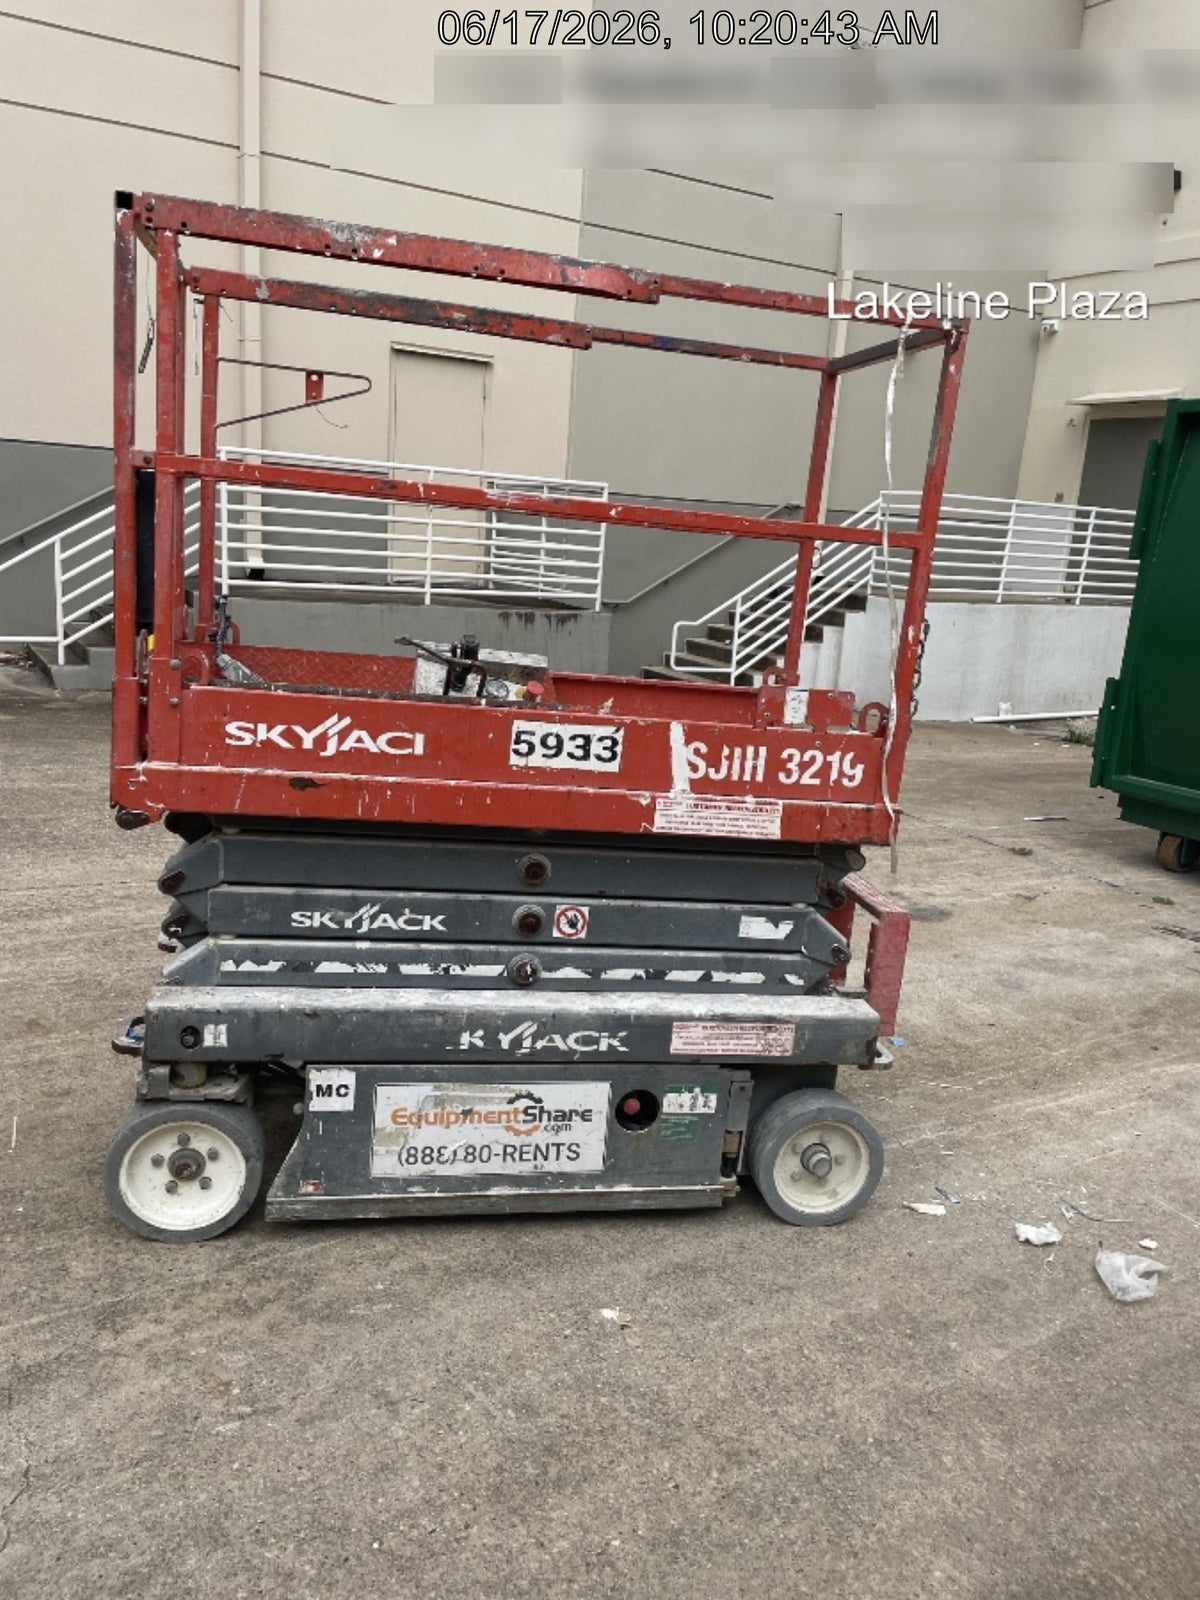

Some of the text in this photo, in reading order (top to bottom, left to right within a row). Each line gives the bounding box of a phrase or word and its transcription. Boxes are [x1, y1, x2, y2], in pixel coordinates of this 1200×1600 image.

[512, 730, 619, 763] 5933
[778, 748, 865, 787] 3219
[445, 1020, 630, 1057] KYJACK
[315, 1084, 350, 1098] MC
[463, 1142, 581, 1164] 80-RENTS
